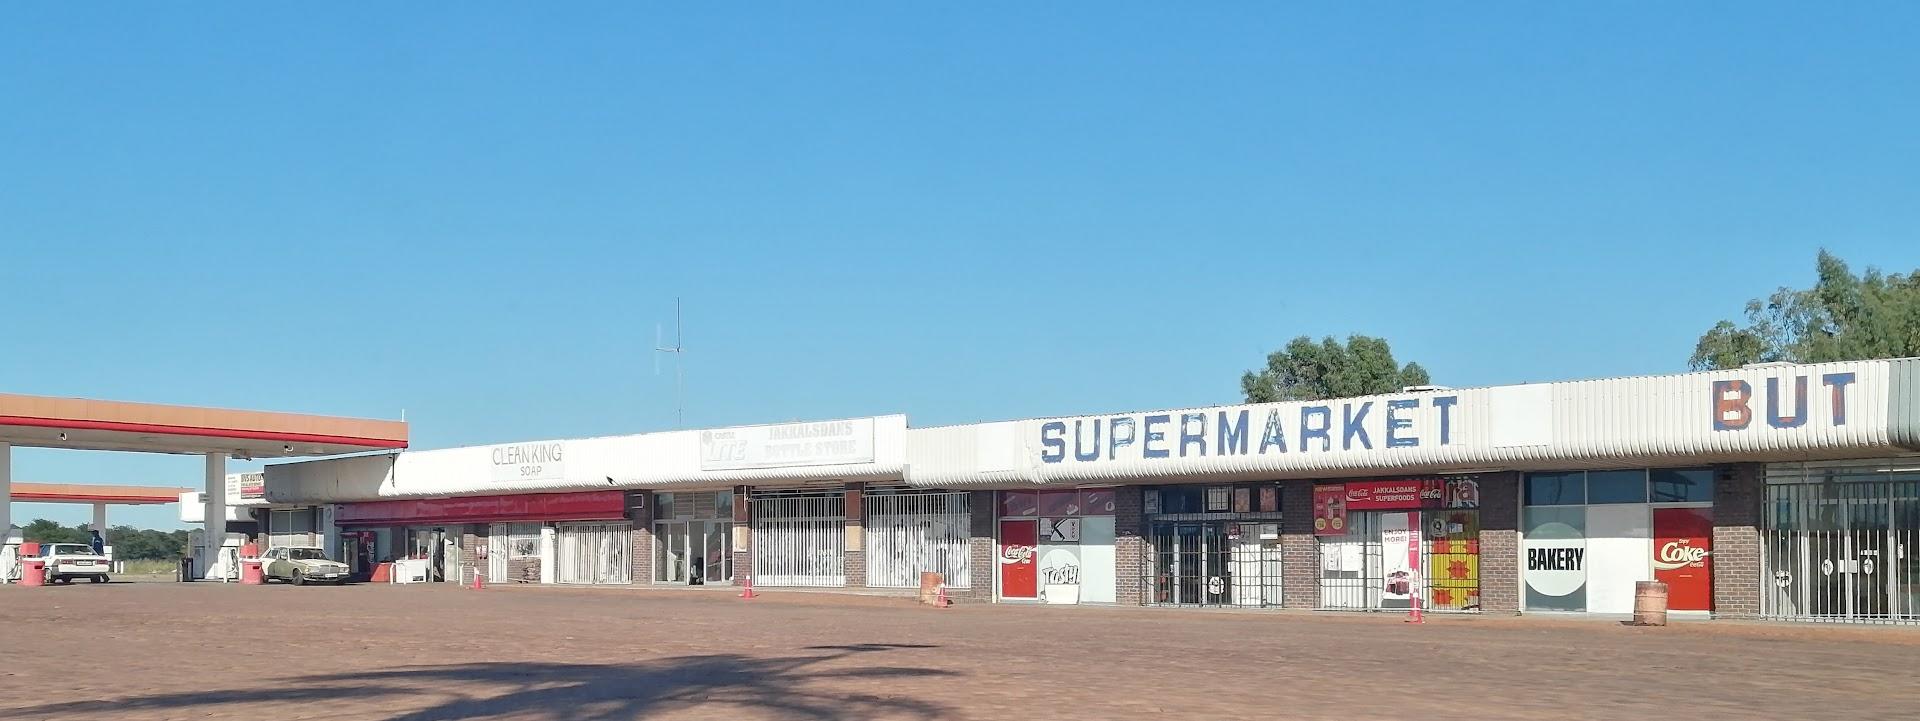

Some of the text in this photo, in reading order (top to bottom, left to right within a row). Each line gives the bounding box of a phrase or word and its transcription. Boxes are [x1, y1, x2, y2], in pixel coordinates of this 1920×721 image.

[1712, 372, 1855, 431] BUT
[1041, 395, 1458, 464] SUPERMARKET
[492, 443, 562, 465] CLEAN KING
[706, 440, 748, 462] LITE
[816, 440, 857, 456] STORE
[520, 465, 542, 476] SOAP
[1375, 494, 1415, 502] SUPERFOODS
[1528, 548, 1584, 570] BAKERY
[1661, 542, 1705, 562] Coke
